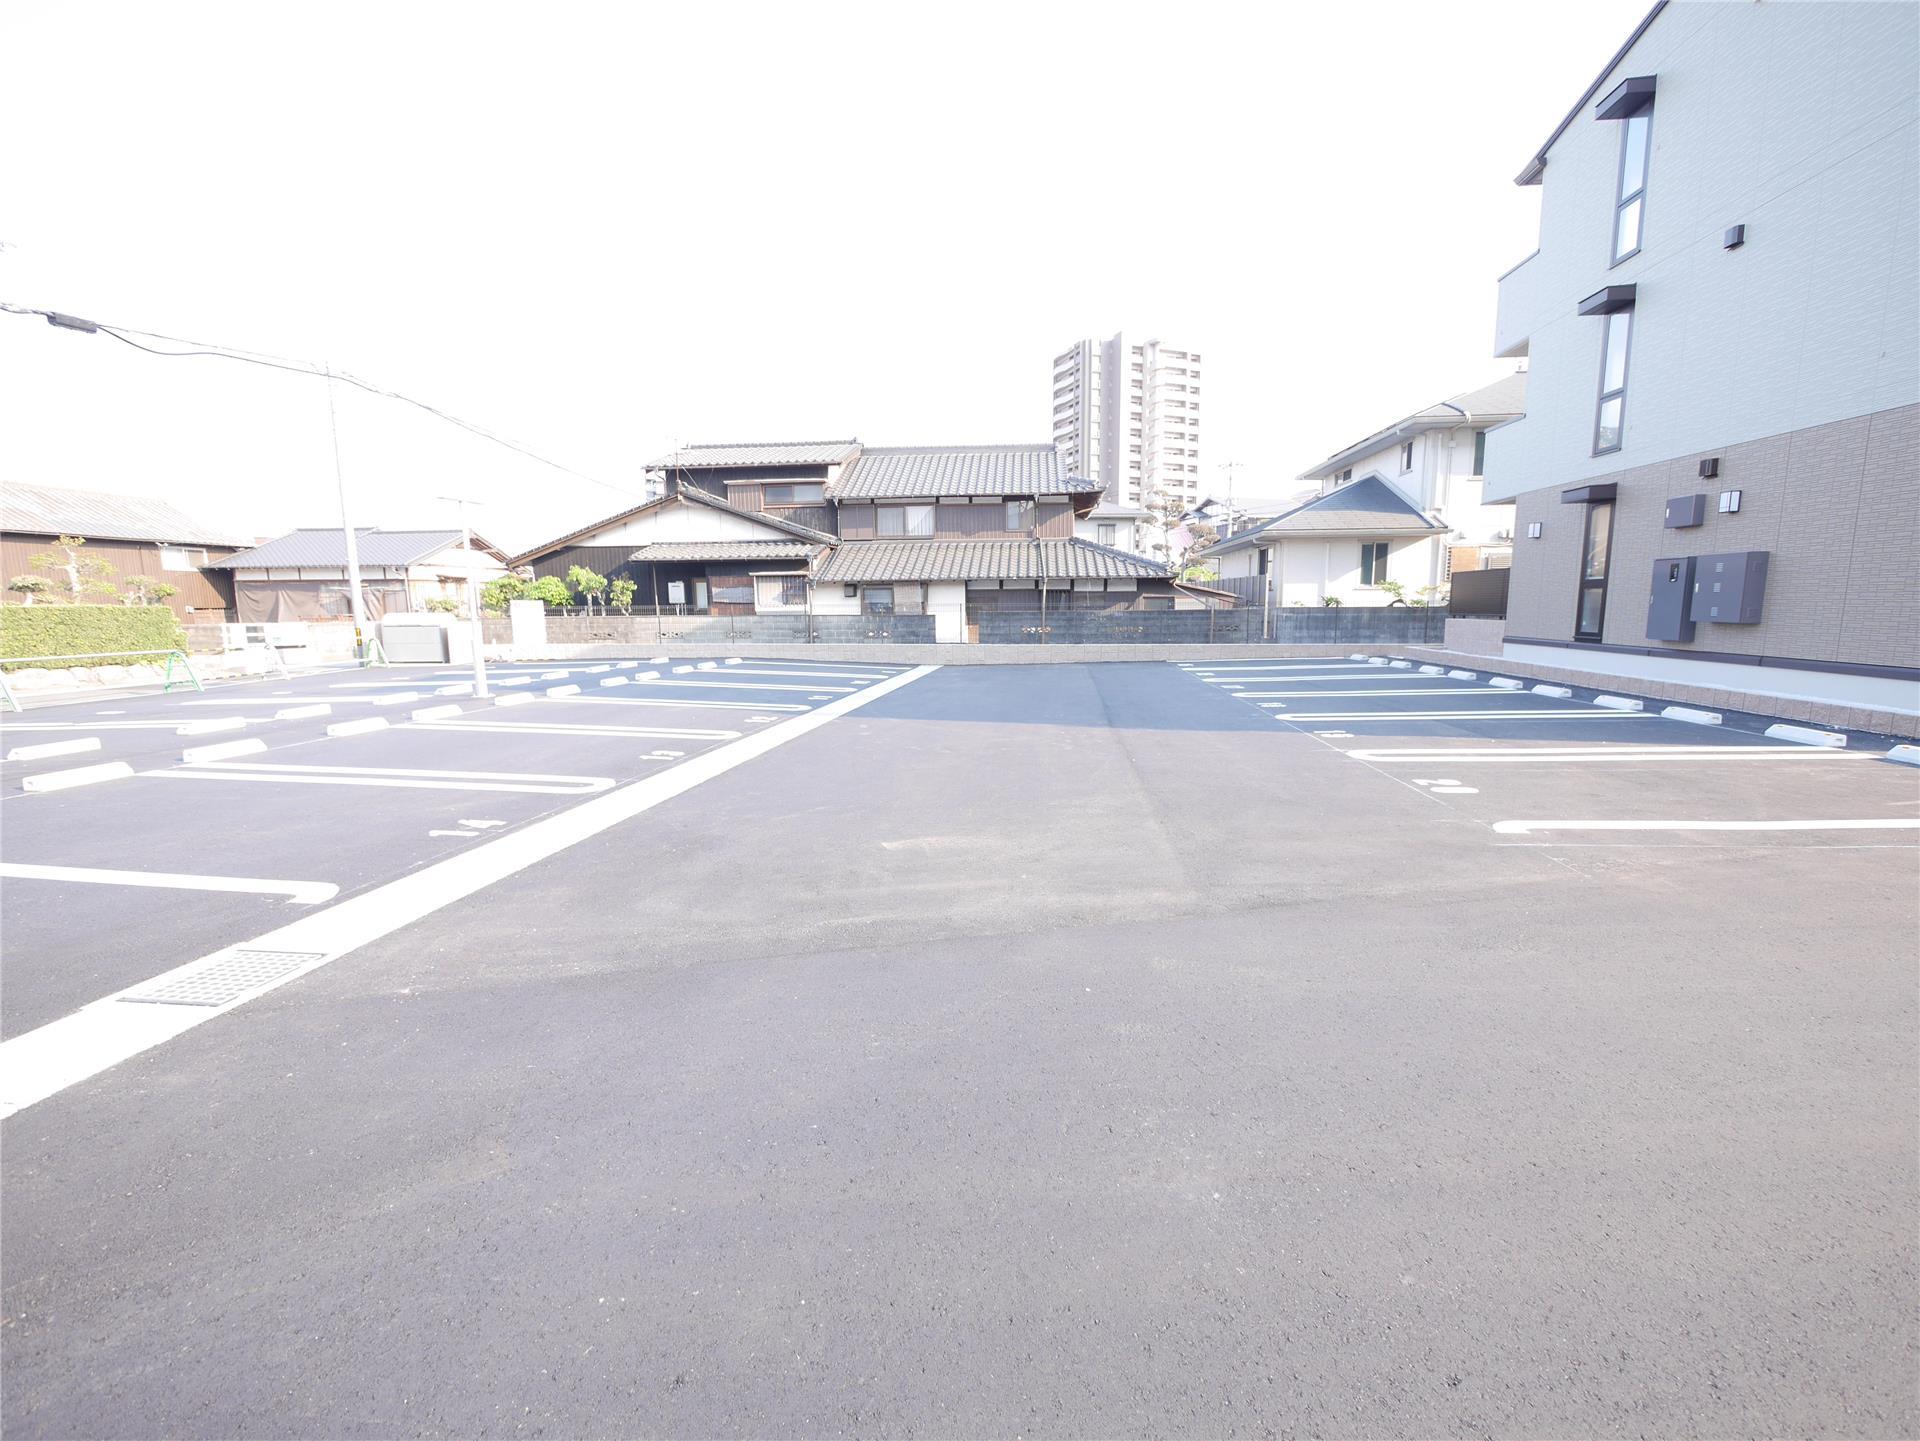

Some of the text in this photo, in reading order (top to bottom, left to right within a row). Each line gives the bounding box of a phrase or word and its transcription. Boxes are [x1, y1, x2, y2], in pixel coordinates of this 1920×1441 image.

[639, 750, 686, 761] 13
[1411, 778, 1480, 794] 20
[429, 818, 508, 837] 14
